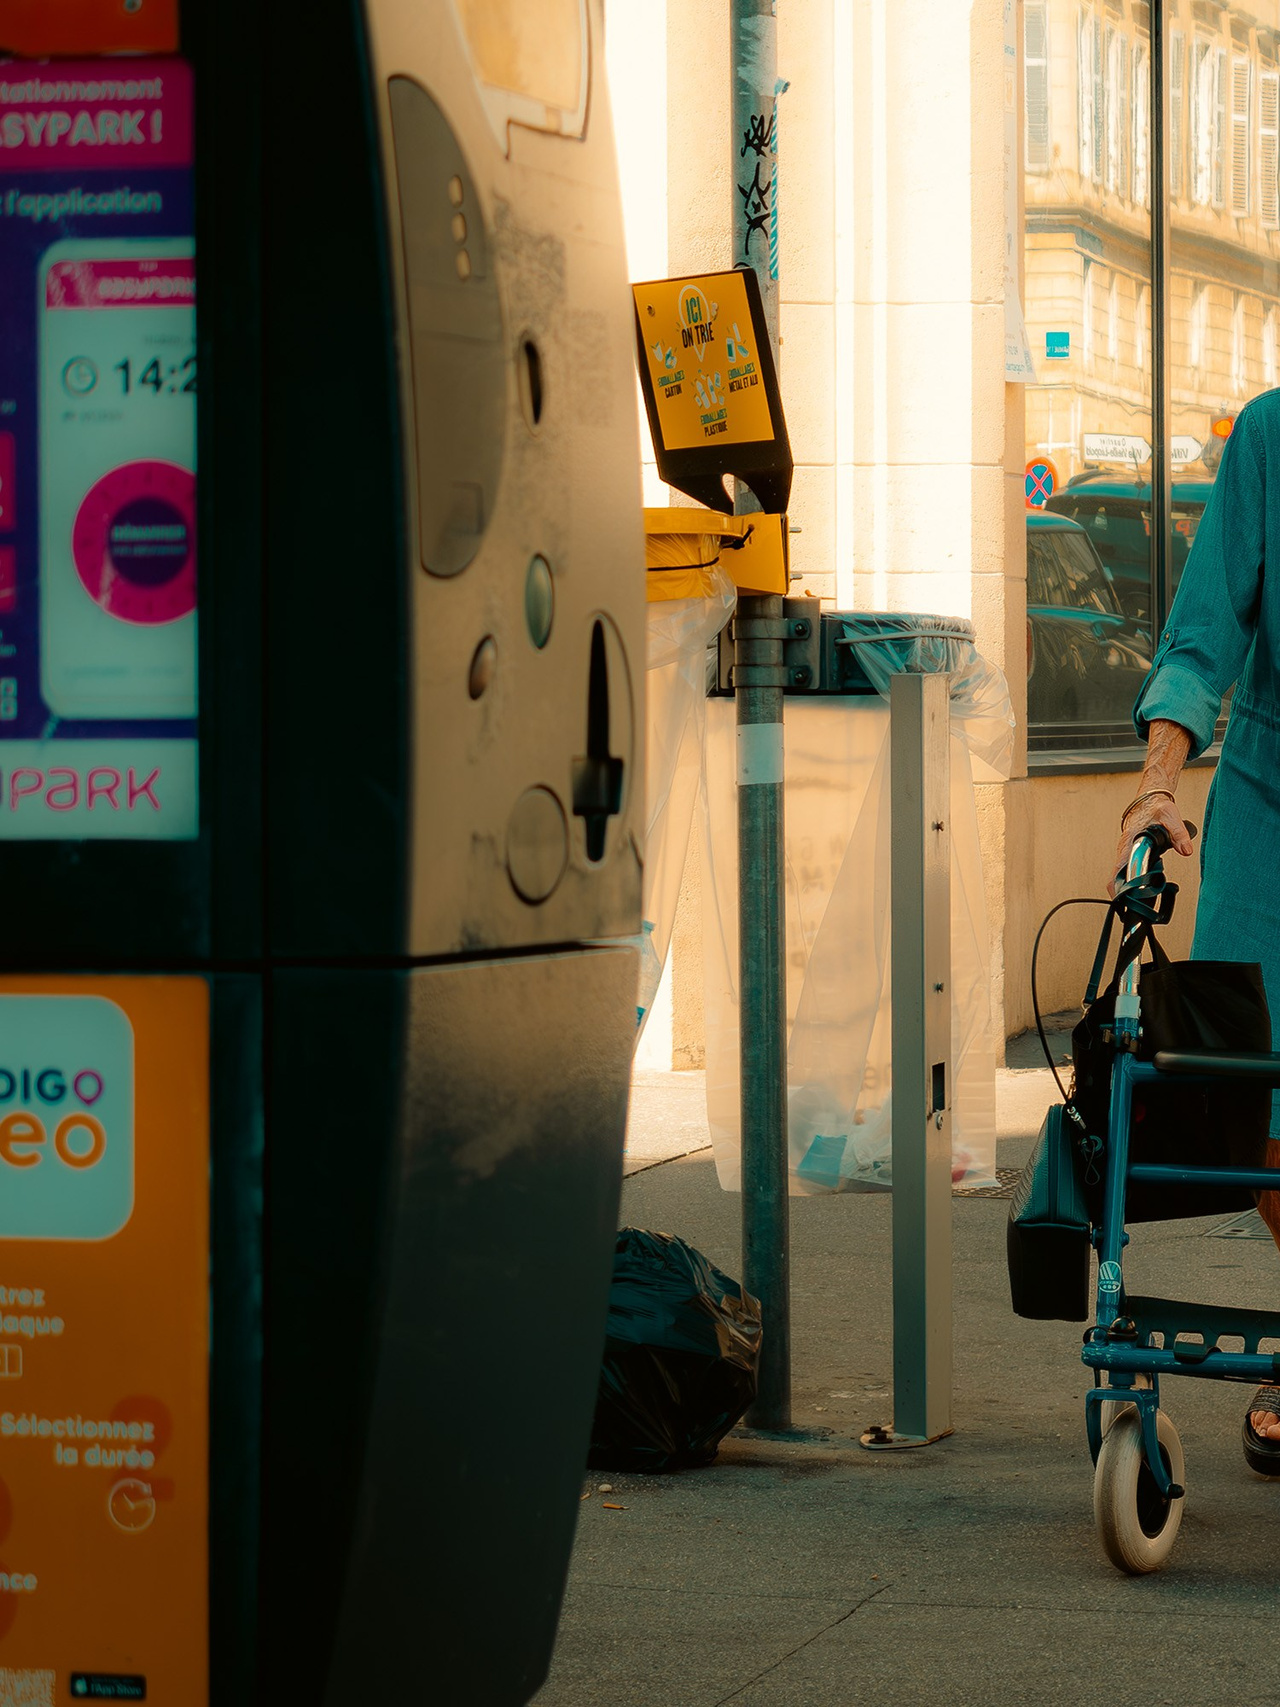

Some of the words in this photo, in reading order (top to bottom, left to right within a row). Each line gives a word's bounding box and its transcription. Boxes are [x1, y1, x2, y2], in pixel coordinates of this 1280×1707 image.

[0, 109, 145, 148] SYPARK
[685, 296, 702, 325] ICI
[681, 329, 694, 349] ON
[695, 322, 715, 346] TRIE
[1, 1412, 155, 1441] Sélectionnez
[55, 1442, 78, 1465] la
[85, 1443, 155, 1469] durée
